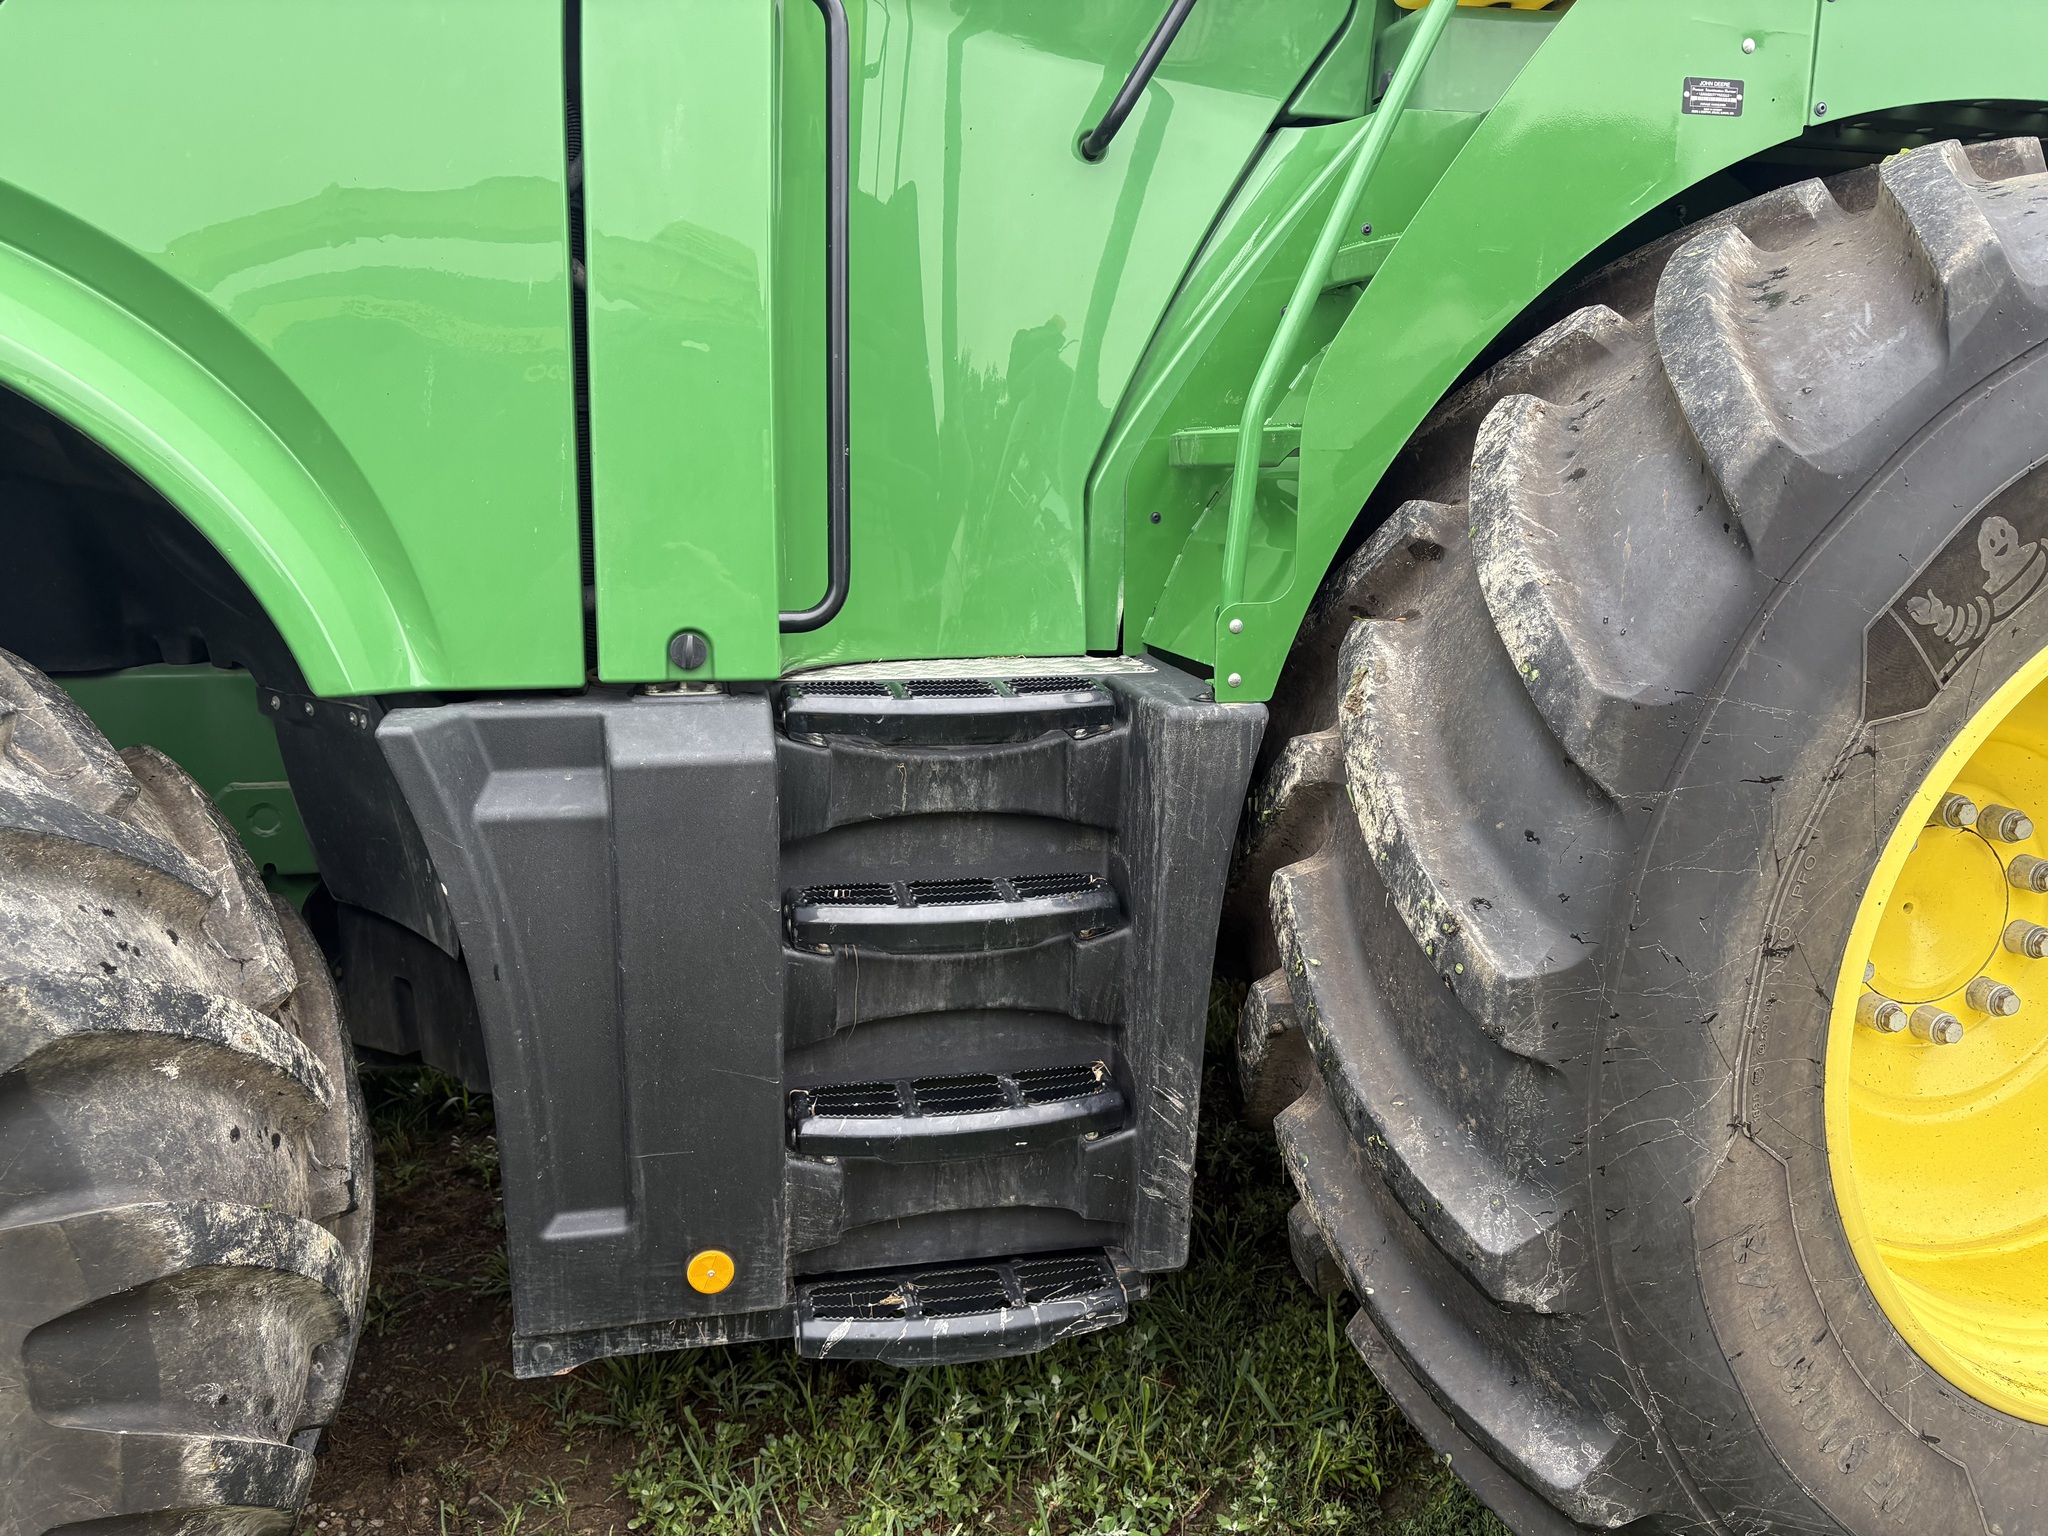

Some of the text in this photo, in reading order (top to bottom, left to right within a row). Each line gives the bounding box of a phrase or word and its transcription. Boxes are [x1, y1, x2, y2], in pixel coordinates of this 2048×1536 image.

[1882, 717, 1961, 835] RADIAL TUBELESS
[1791, 855, 1817, 898] PFO
[1732, 1230, 1916, 1525] VF 900/60 R42
